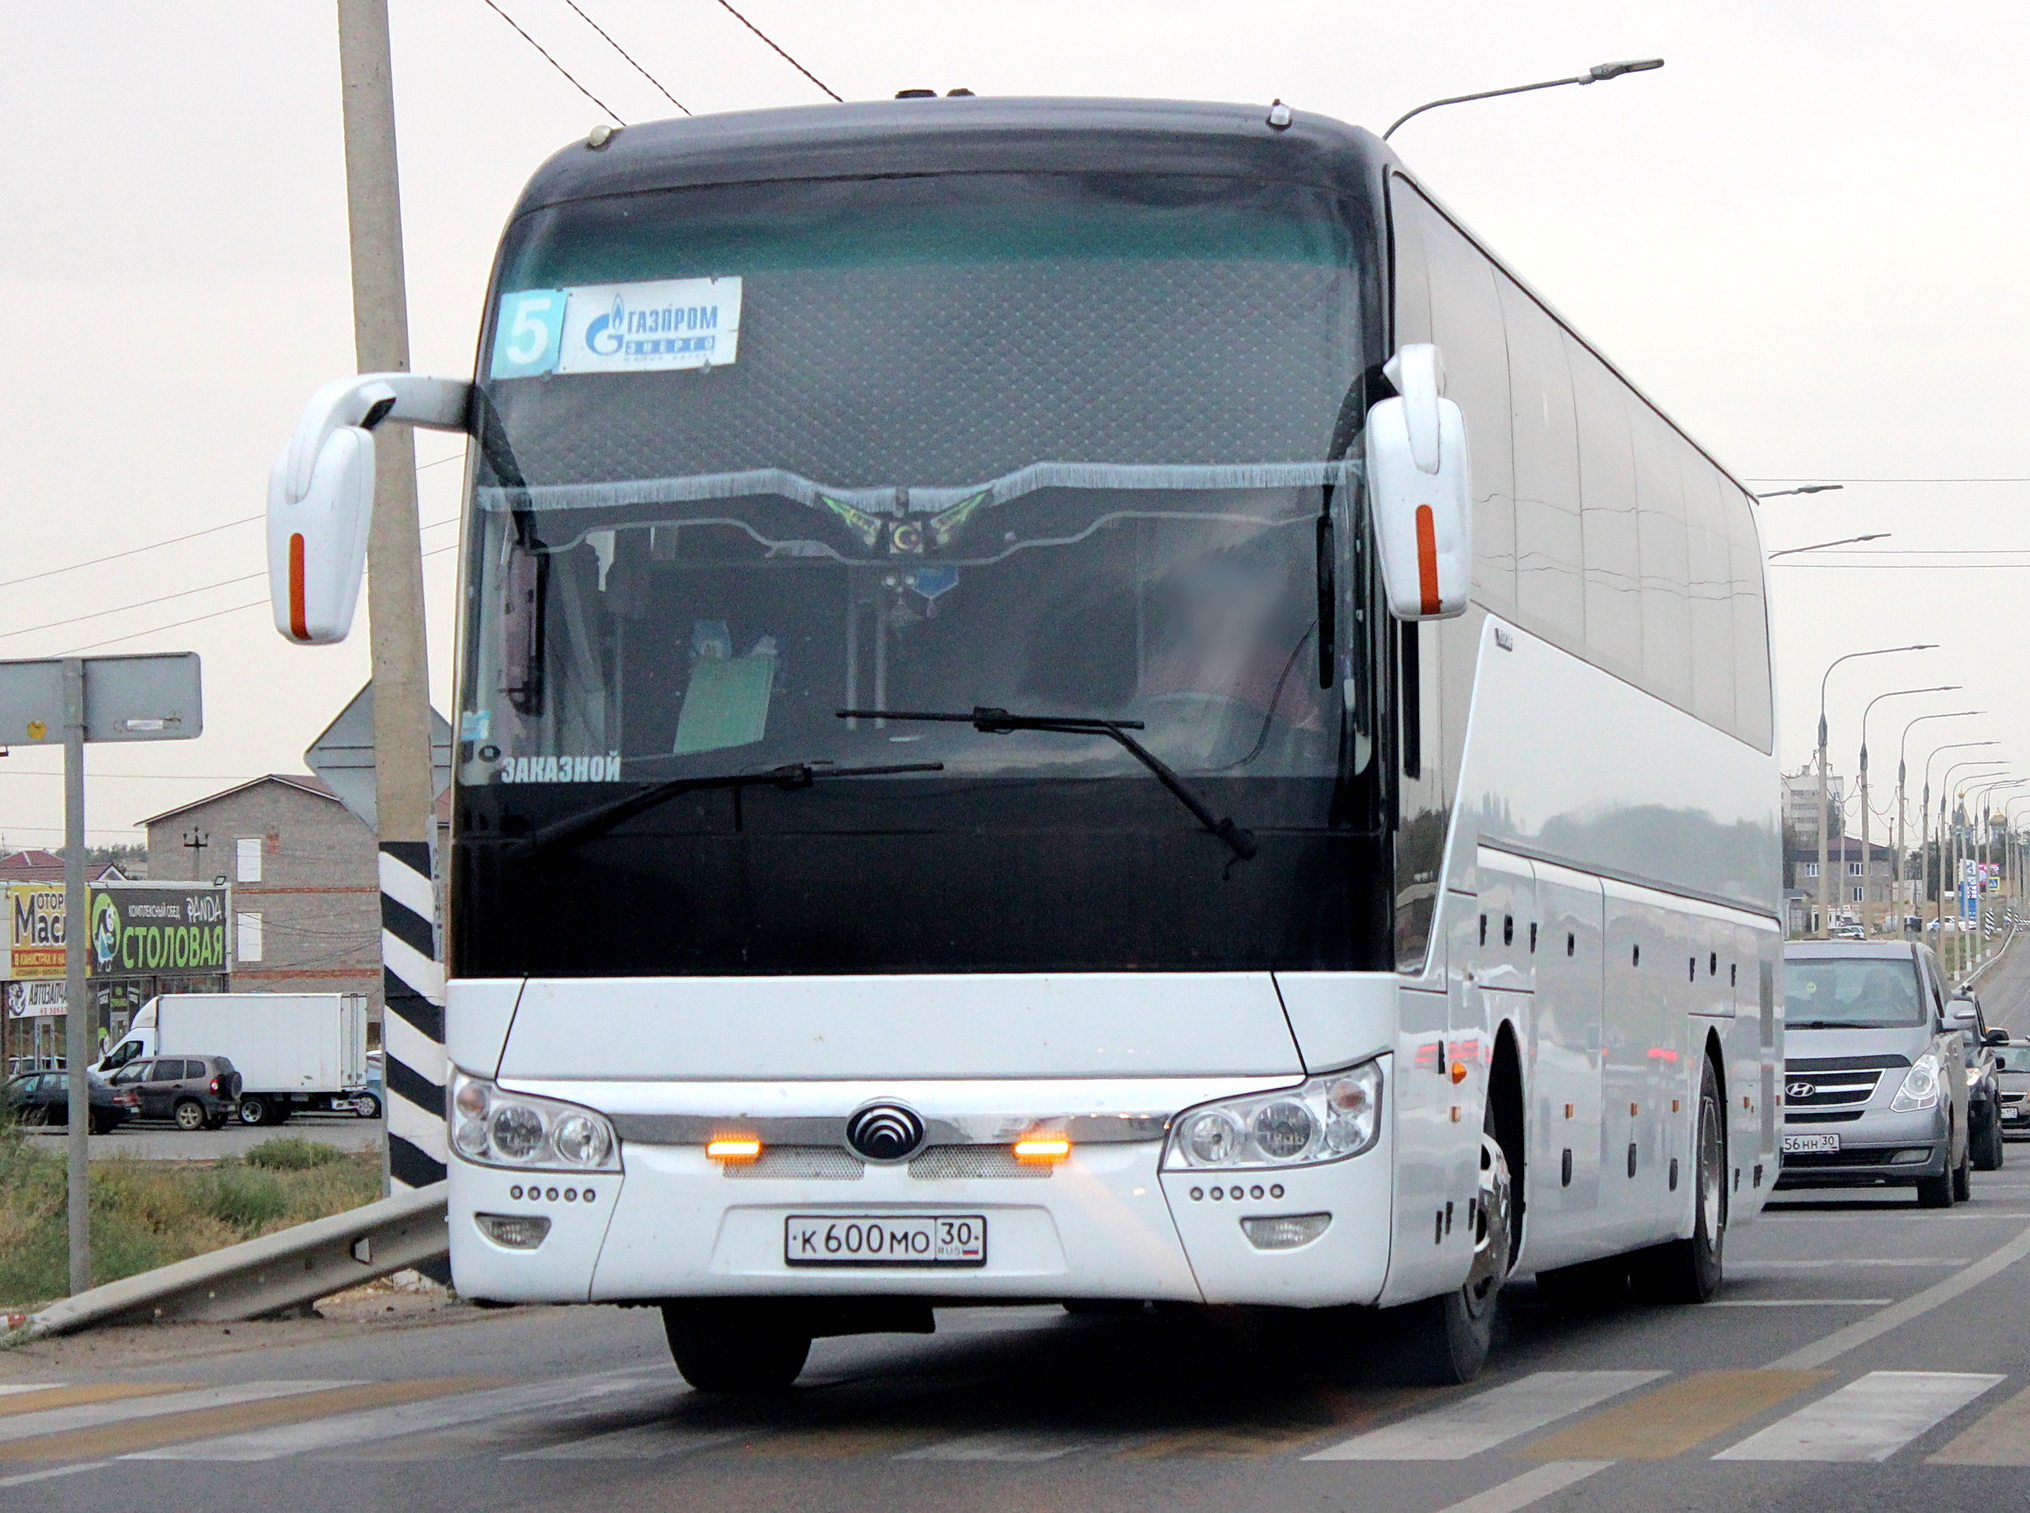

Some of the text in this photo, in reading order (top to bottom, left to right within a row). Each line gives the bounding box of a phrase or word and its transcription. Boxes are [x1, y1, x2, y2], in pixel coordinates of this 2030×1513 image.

[506, 297, 552, 365] 5
[627, 305, 718, 334] ГАЗПРОМ
[501, 750, 622, 783] ЗАКАЗНОЙ
[122, 926, 223, 969] СТОЛОВАЯ
[1822, 1136, 1834, 1145] 30
[941, 1222, 971, 1245] 30
[938, 1246, 961, 1256] RUS
